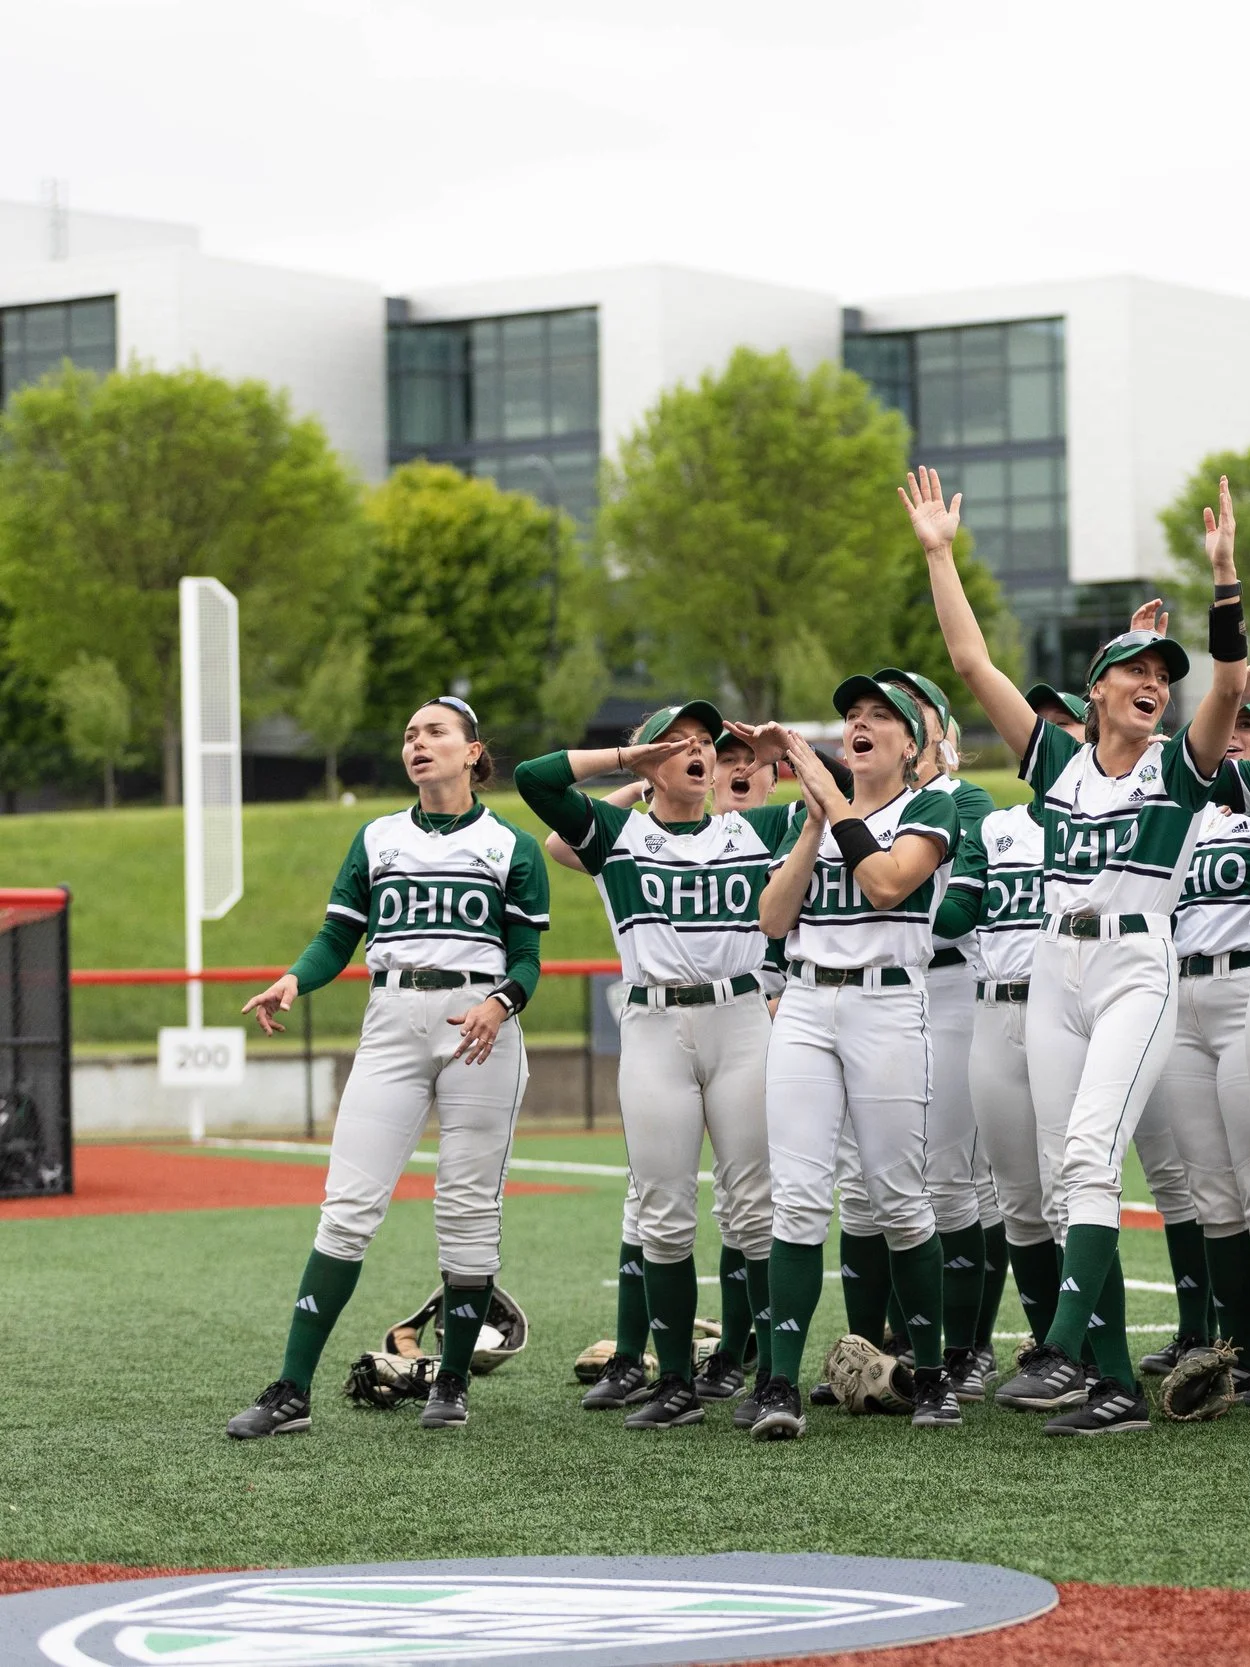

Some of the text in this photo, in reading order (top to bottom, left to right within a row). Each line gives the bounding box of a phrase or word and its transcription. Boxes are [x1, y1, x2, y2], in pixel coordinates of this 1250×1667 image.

[640, 873, 752, 915] OHIO
[803, 866, 862, 908] OHI
[1181, 852, 1247, 895] HIO
[378, 886, 489, 927] OHIO
[987, 876, 1041, 918] OH
[174, 1043, 231, 1072] 200
